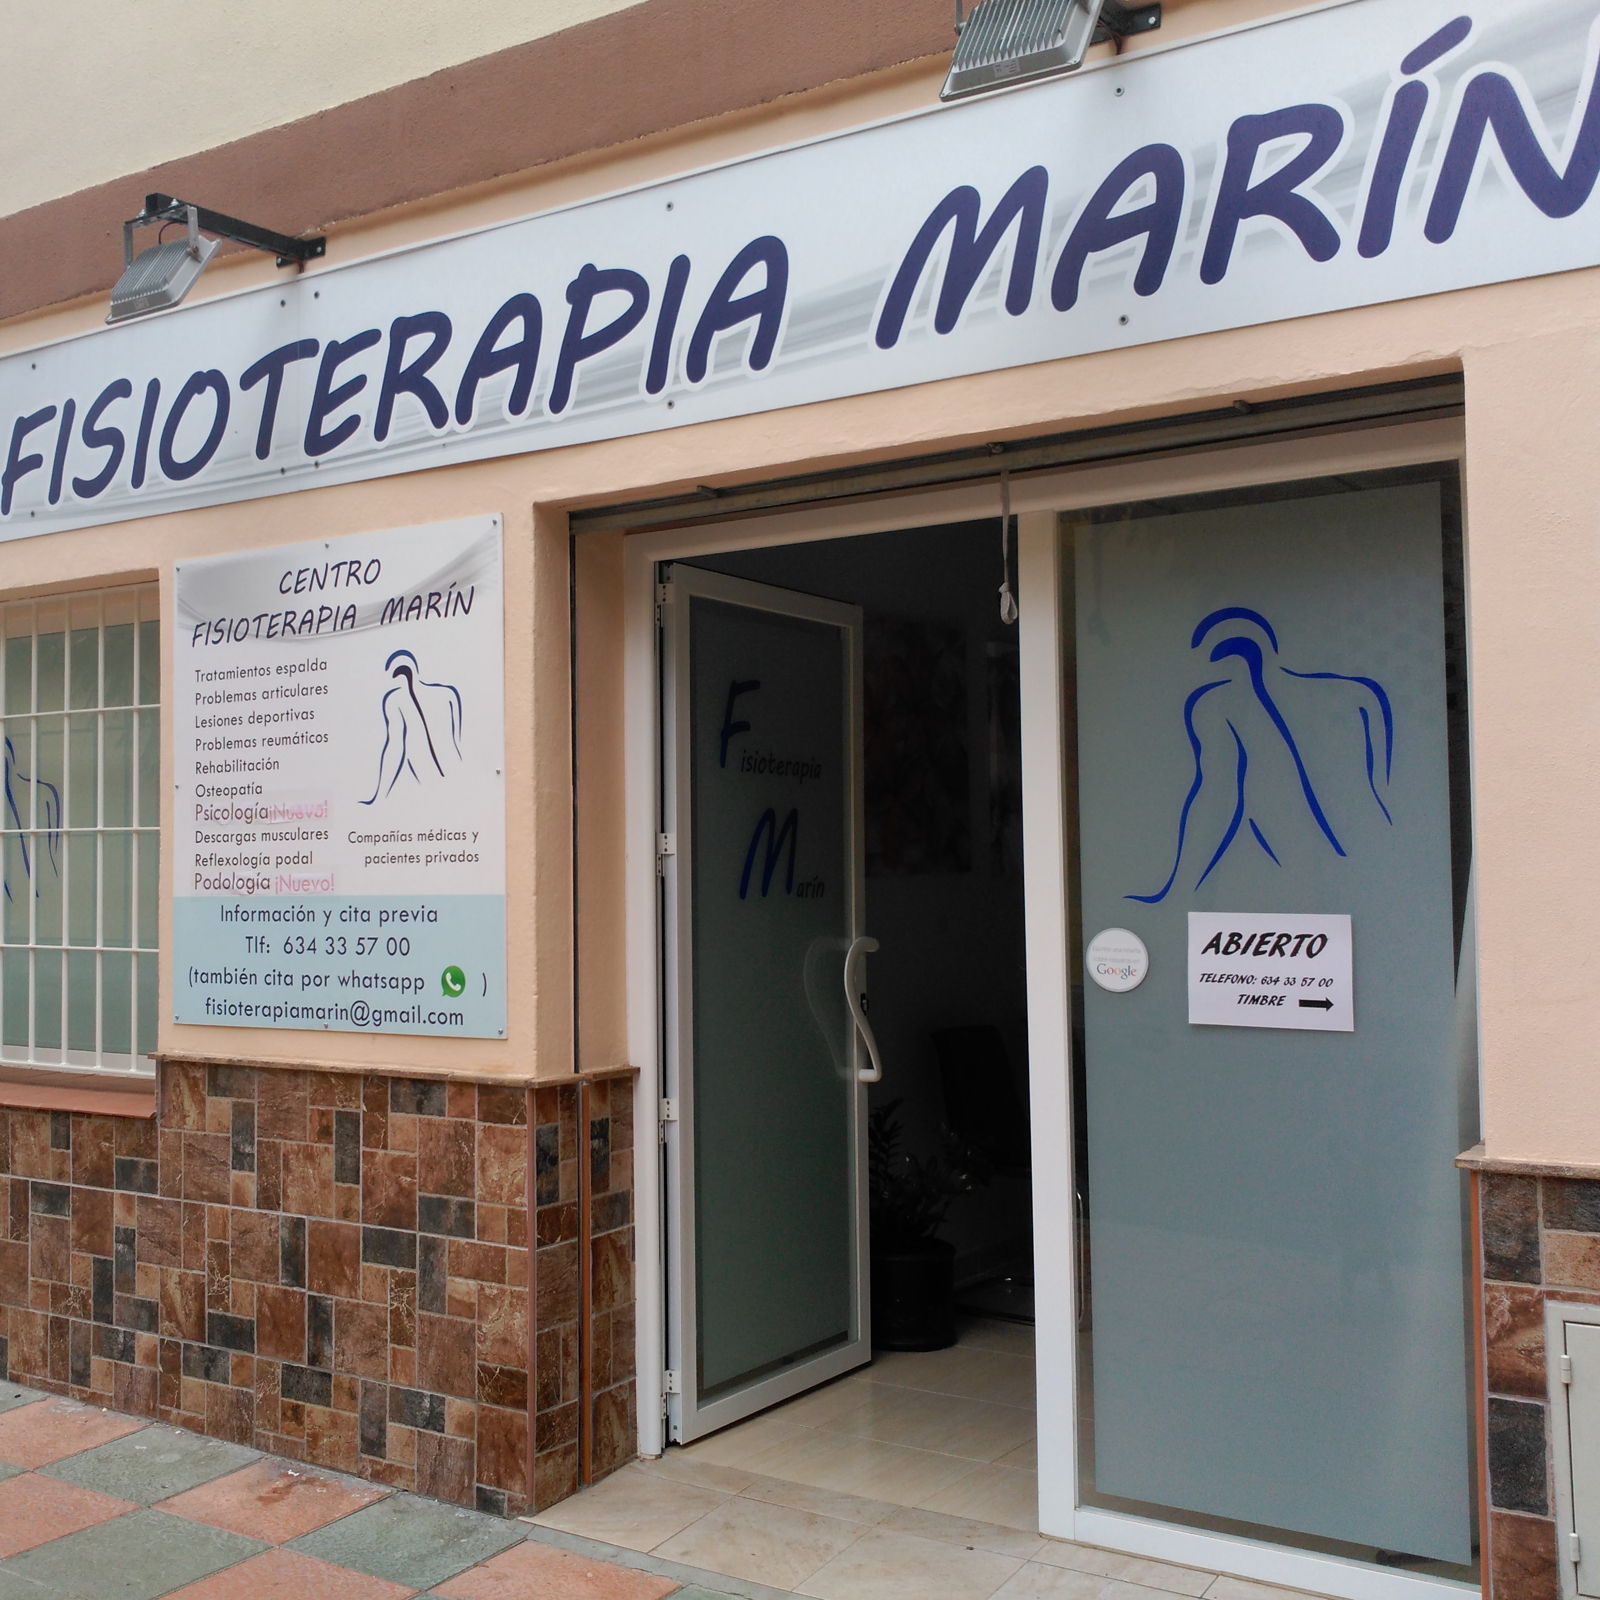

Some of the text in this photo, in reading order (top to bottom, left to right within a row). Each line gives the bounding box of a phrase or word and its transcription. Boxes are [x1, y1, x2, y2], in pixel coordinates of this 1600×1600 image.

[2, 16, 1600, 516] FISIOTERAPIA MARÍN
[279, 559, 381, 595] CENTRO
[192, 581, 475, 648] FISIOTERAPIA MARÍN
[195, 659, 328, 683] Tratamientos espalda
[195, 683, 329, 706] Problemas articulares
[195, 706, 315, 729] Lesiones deportivas
[195, 731, 329, 752] Problemas reumáticos
[195, 757, 280, 776] Rehabilitación
[195, 782, 263, 799] Osteopatía
[195, 827, 329, 846] Descargas musculares
[347, 828, 479, 846] Compañías médicas y
[195, 851, 313, 870] Reflexología podal
[364, 851, 480, 868] pacientes privados
[194, 872, 271, 895] Podología
[220, 904, 439, 928] Información y cita previa
[245, 935, 411, 956] Tlf: 634 33 57 00
[1201, 931, 1328, 958] ABIERTO
[188, 966, 258, 988] (también
[264, 968, 294, 986] cita
[301, 973, 330, 993] por
[337, 970, 425, 994] whatsapp
[1096, 962, 1137, 980] Google
[1199, 973, 1334, 988] TELEFONO: 634 33 57 00
[1236, 994, 1287, 1006] TIMBRE
[205, 998, 464, 1027] fisioterapiamarin@gmail.com
